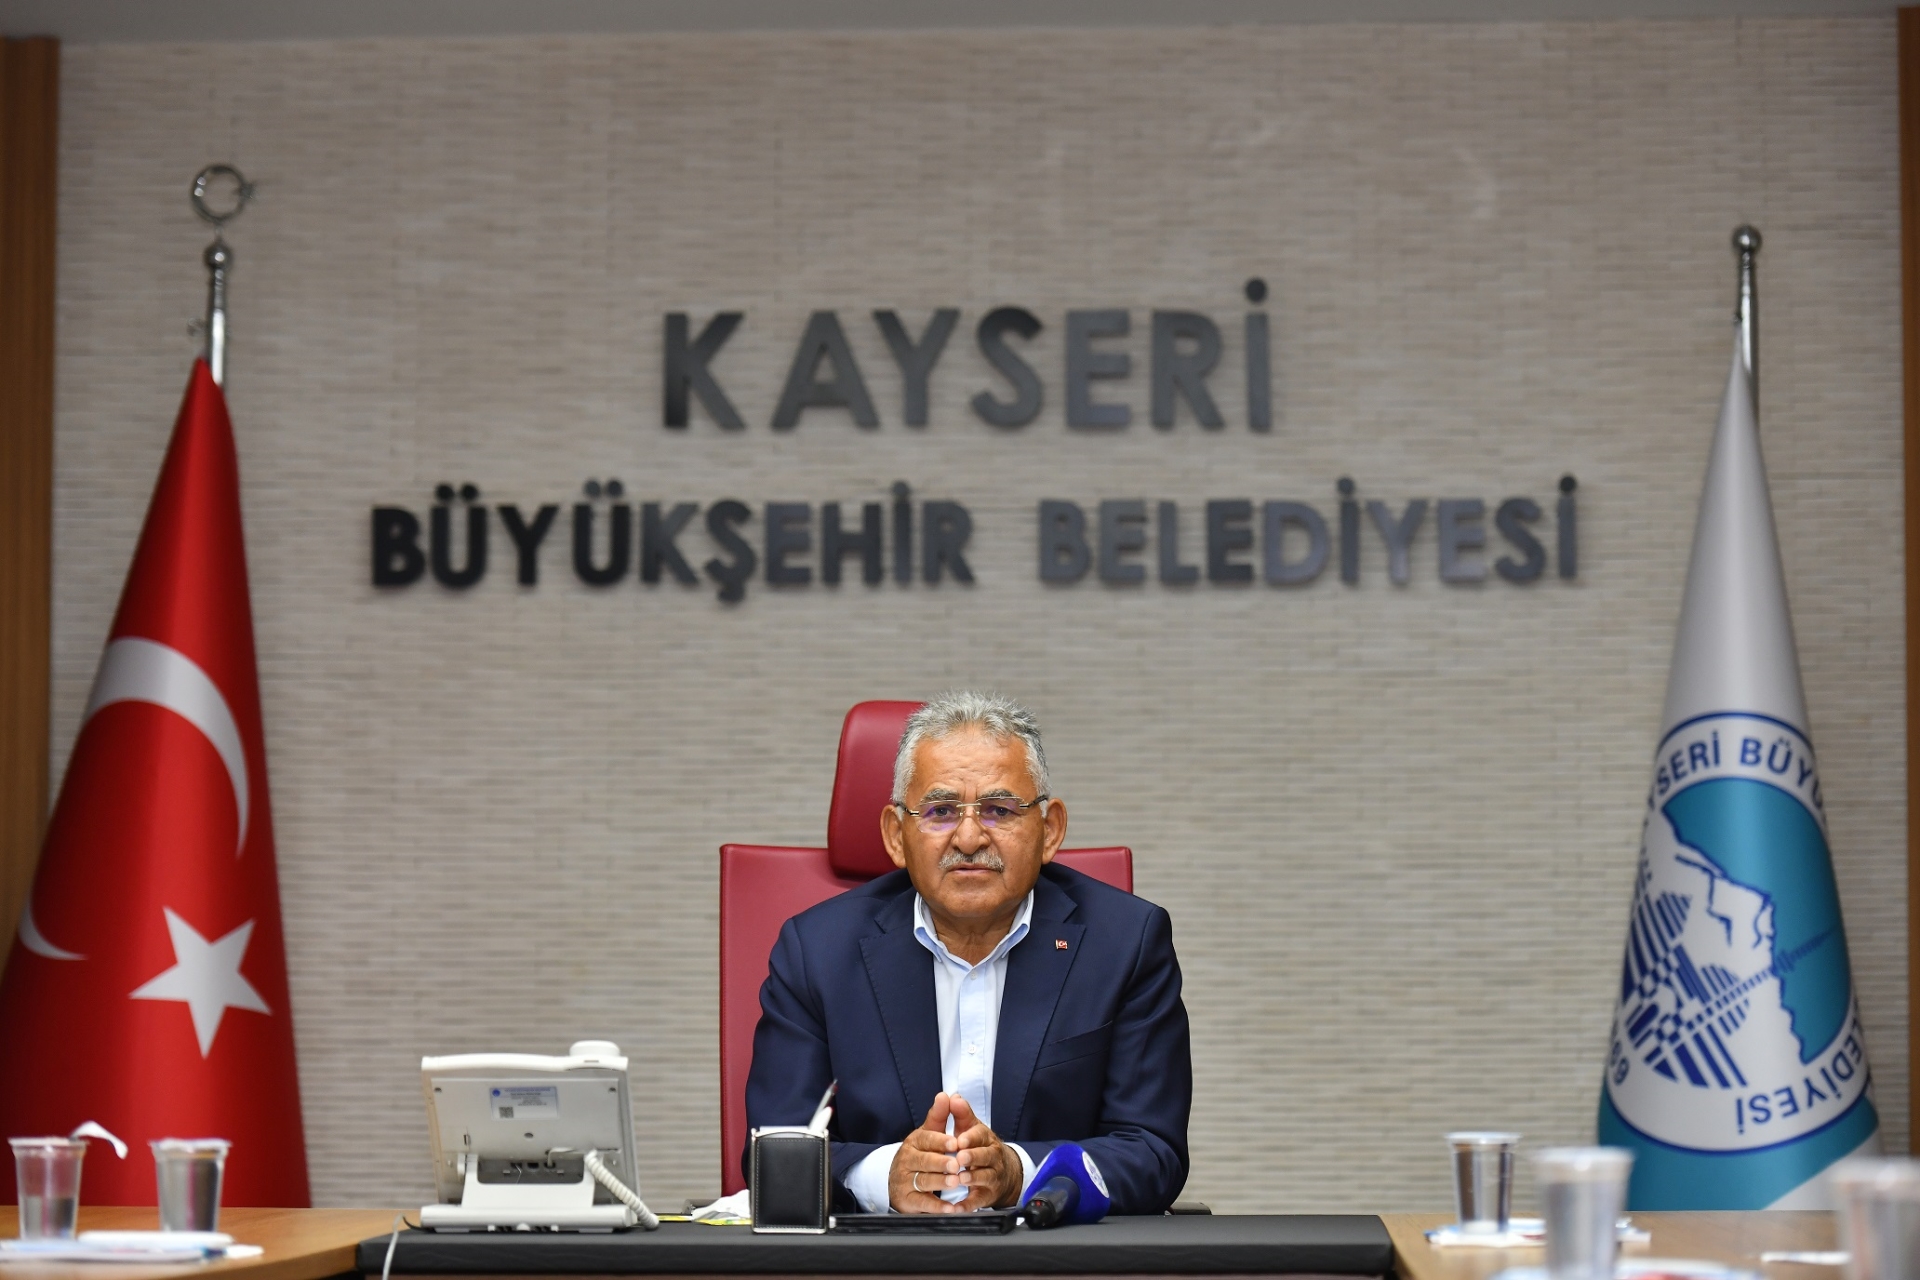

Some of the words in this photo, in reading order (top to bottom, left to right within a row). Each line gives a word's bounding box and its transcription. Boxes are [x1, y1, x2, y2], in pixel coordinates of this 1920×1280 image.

[664, 278, 1272, 432] KAYSERİ
[371, 479, 976, 602] BÜYÜKŞEHİR
[1038, 473, 1578, 586] BELEDİYESİ
